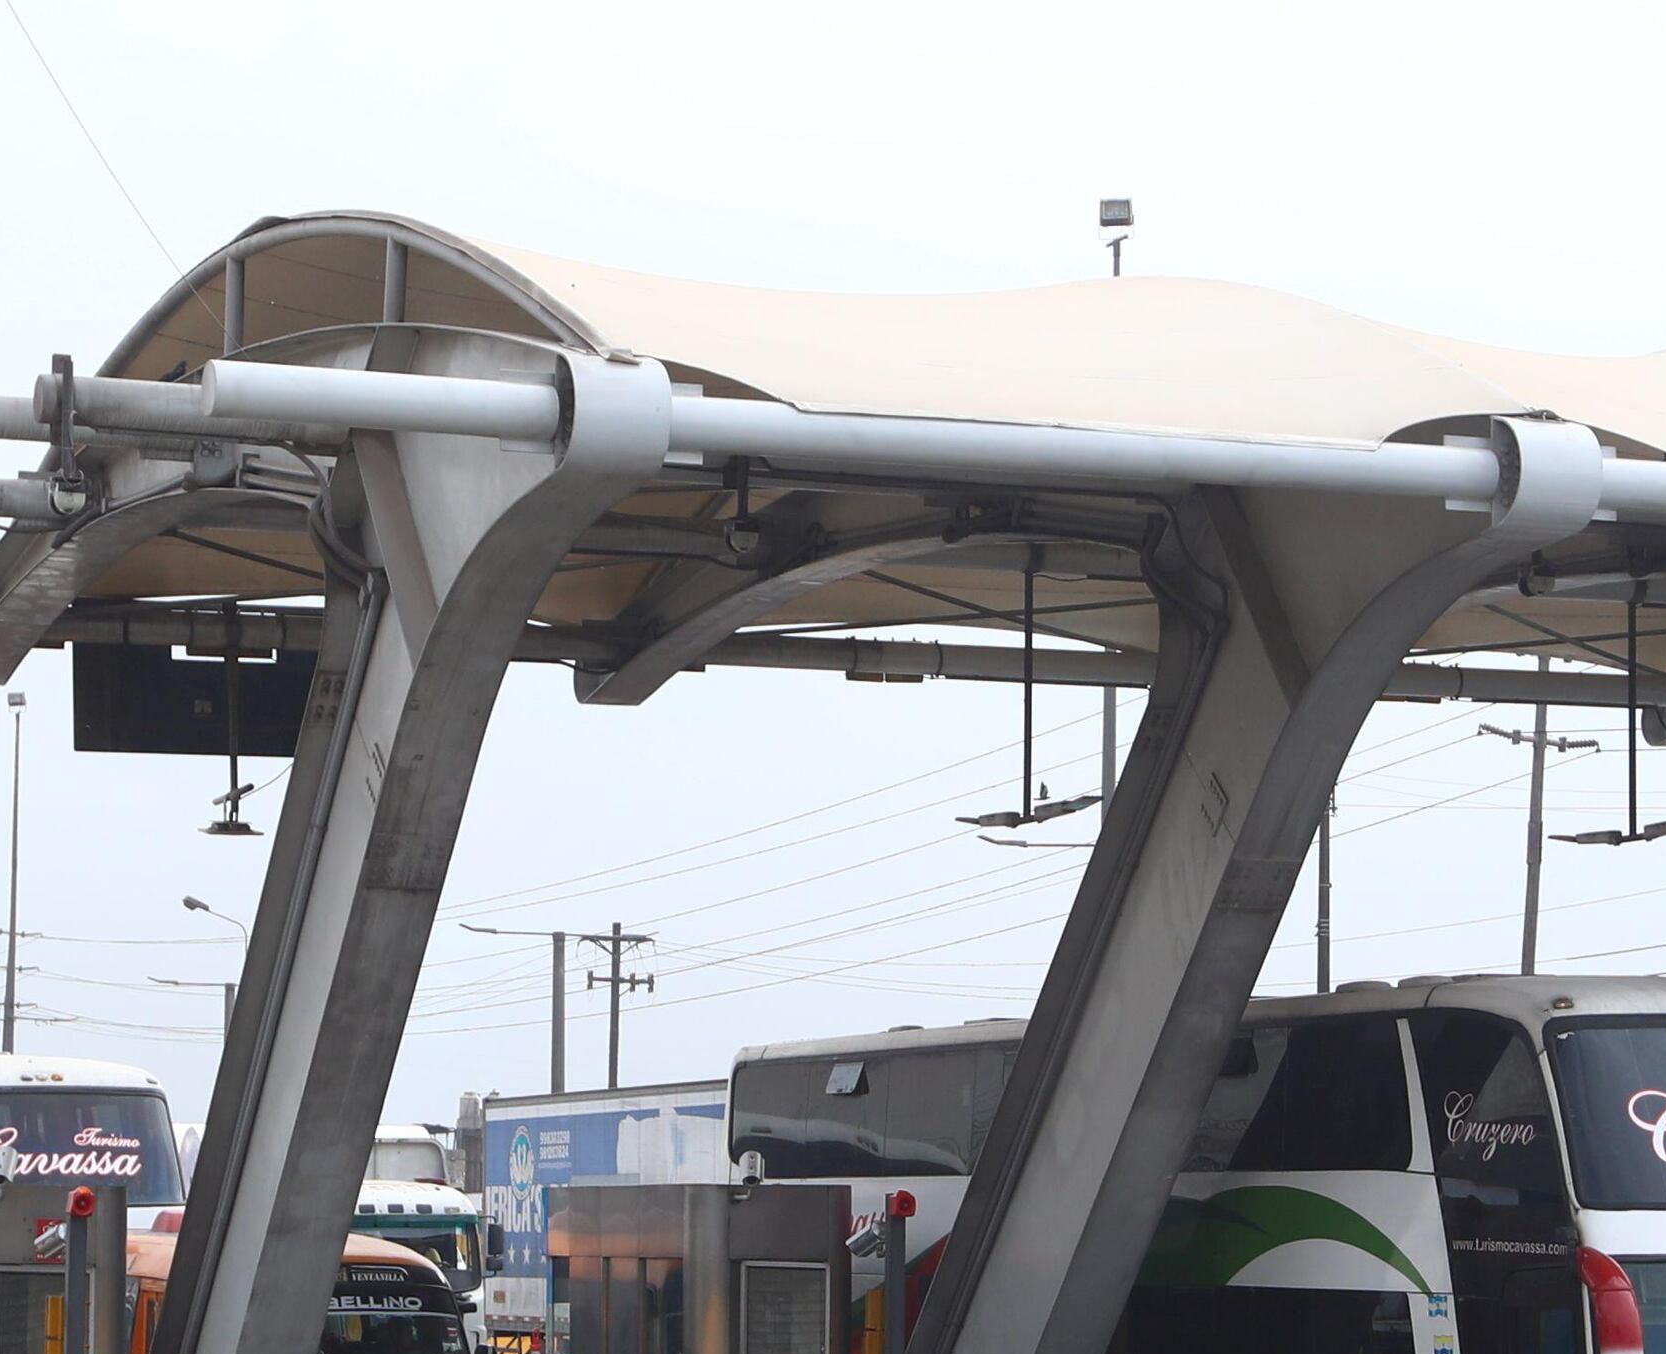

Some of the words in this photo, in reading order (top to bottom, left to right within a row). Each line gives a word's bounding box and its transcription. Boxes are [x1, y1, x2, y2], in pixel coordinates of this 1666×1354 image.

[1443, 1090, 1536, 1161] Cruzero
[73, 1127, 141, 1148] Turismo
[352, 1272, 405, 1282] VENTANILLA
